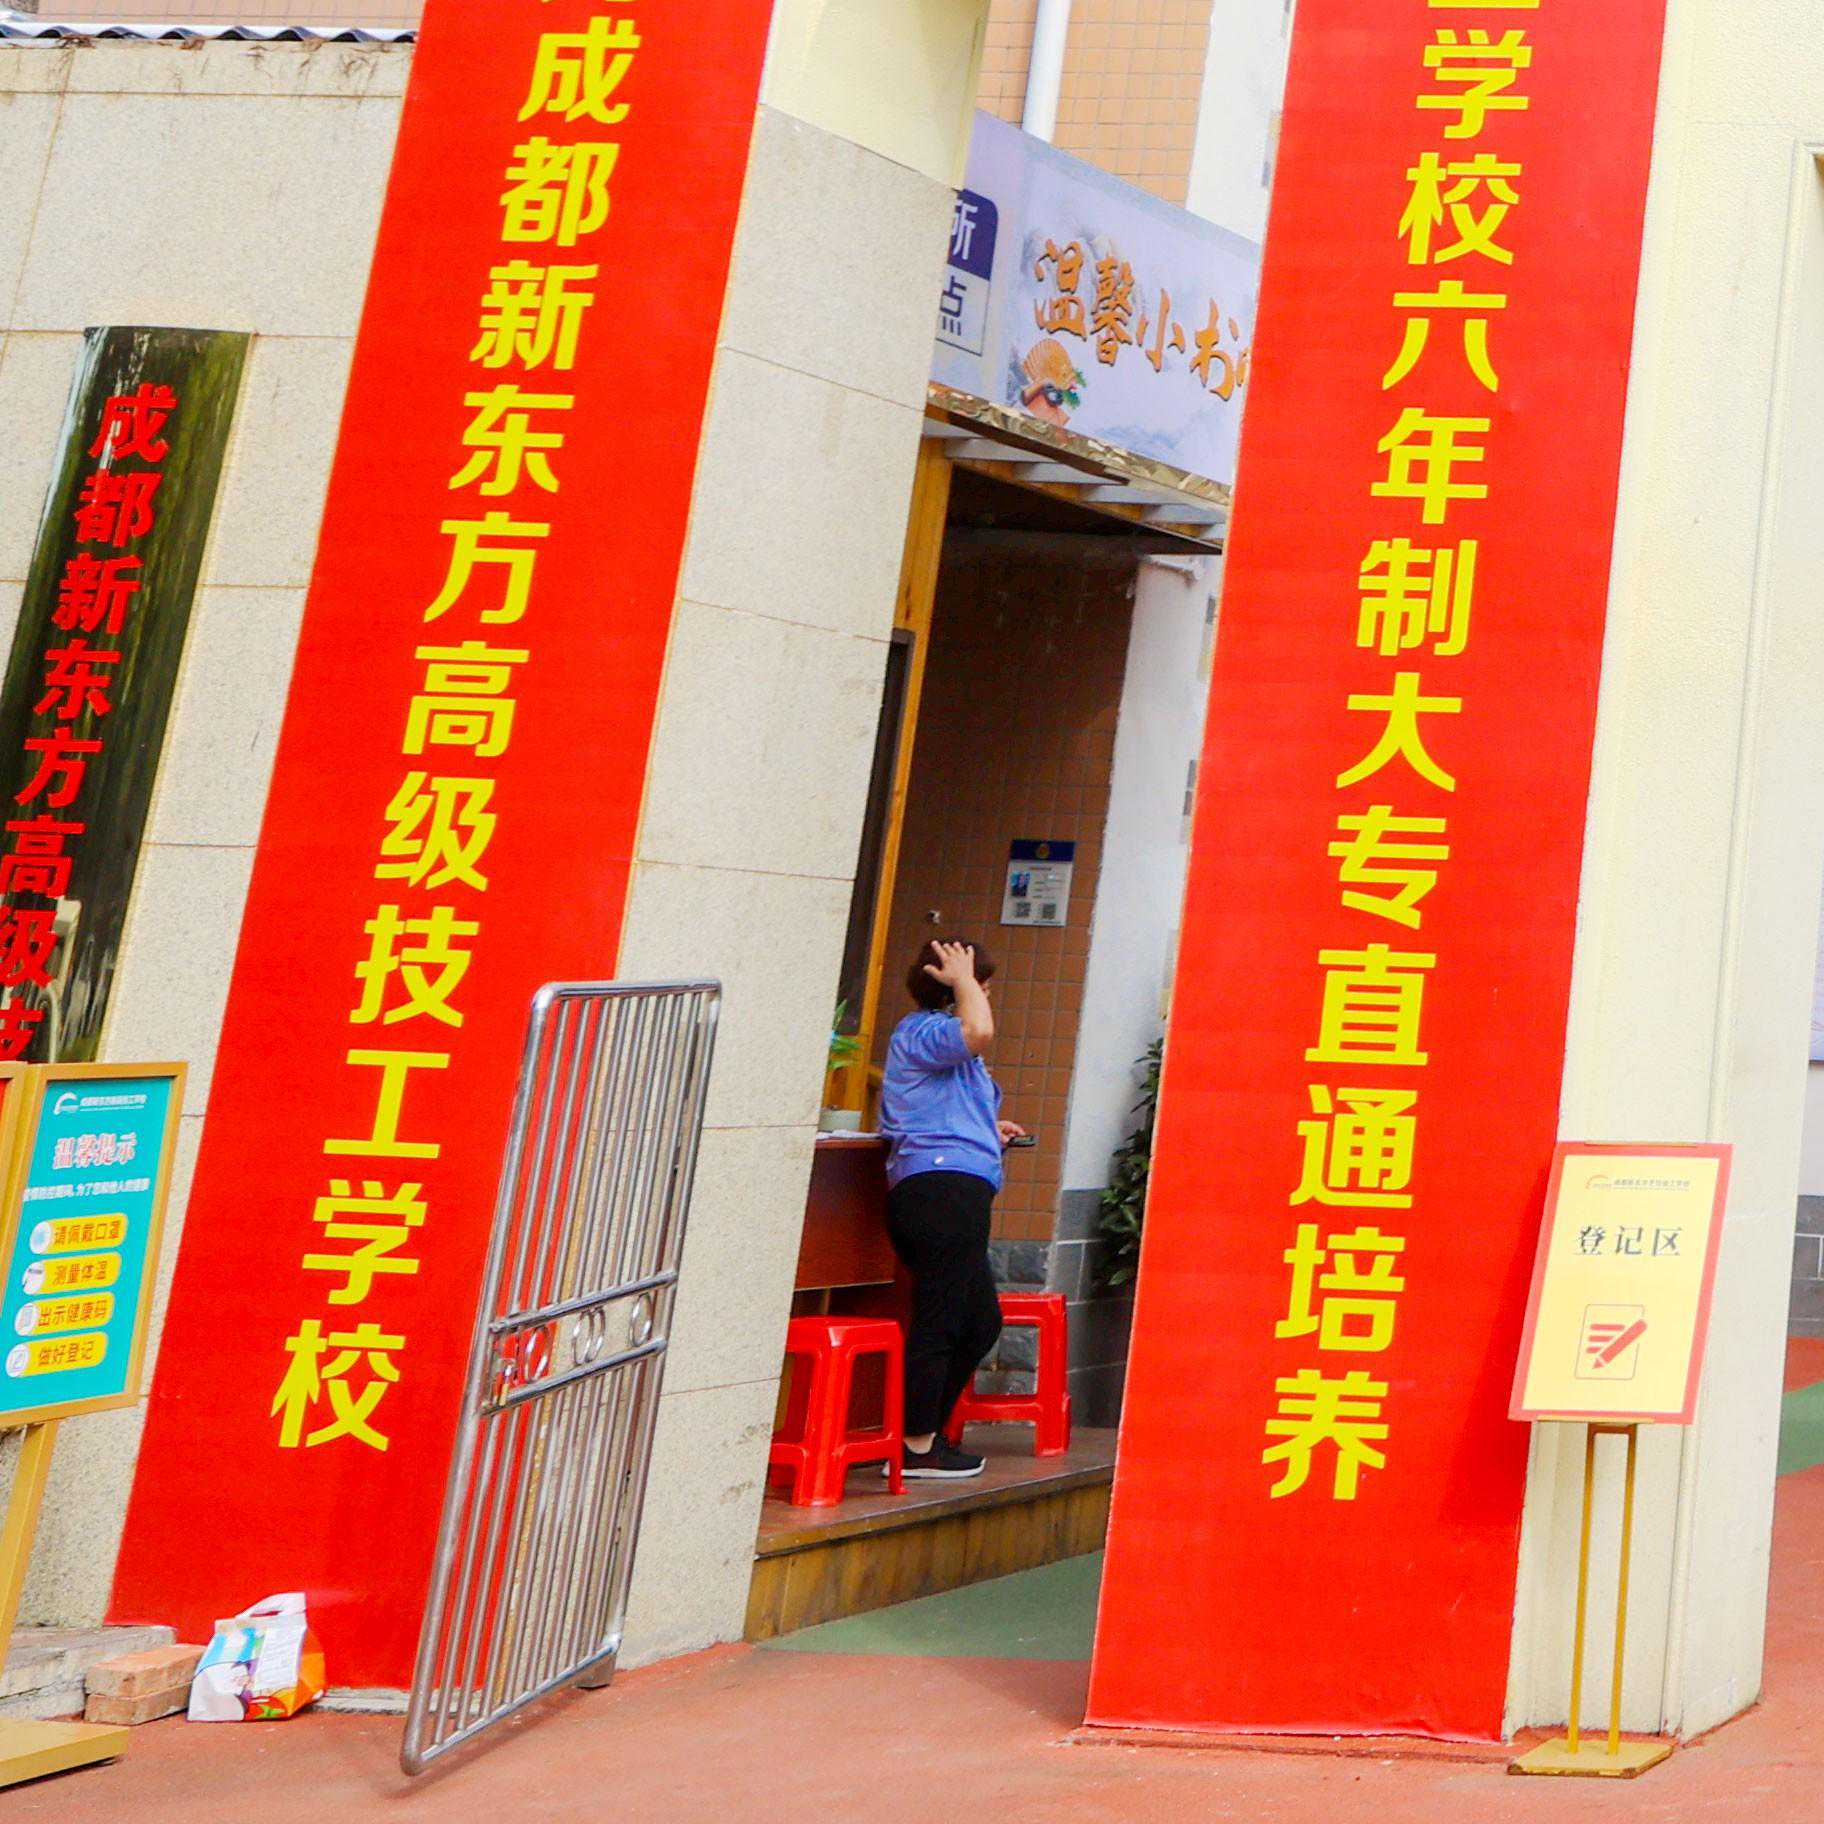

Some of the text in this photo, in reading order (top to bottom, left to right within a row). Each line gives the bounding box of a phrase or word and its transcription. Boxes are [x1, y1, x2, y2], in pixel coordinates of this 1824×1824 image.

[1034, 239, 1250, 402] 温馨小书
[53, 1132, 137, 1169] 温馨提示
[54, 1220, 122, 1245] 请佩戴口罩
[1574, 1226, 1682, 1257] 登记区
[53, 1260, 108, 1286] 测量体温
[38, 1299, 108, 1327] 出示健康码
[38, 1341, 96, 1366] 做好登记
